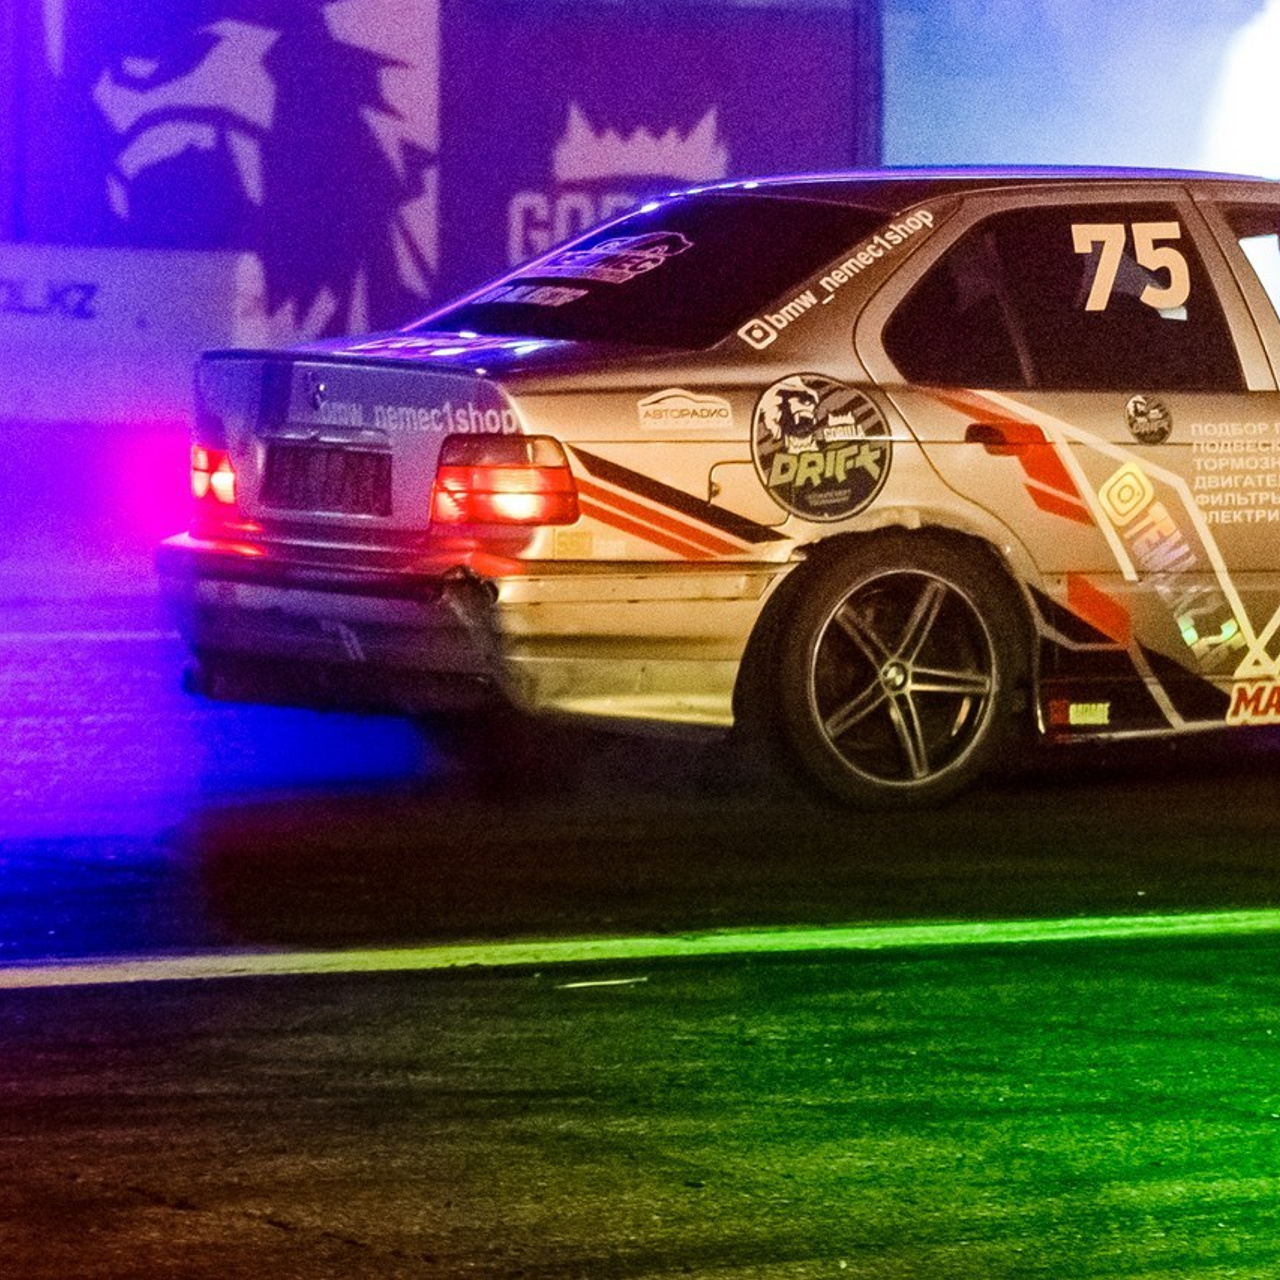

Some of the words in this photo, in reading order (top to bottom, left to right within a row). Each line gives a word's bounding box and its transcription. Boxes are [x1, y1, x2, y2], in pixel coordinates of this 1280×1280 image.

[763, 209, 934, 331] bmw_nemec1shop
[1070, 221, 1191, 312] 75
[643, 407, 729, 420] АВТОРАДИО
[1191, 422, 1268, 437] ПОДБОР
[768, 443, 881, 487] DRIFT
